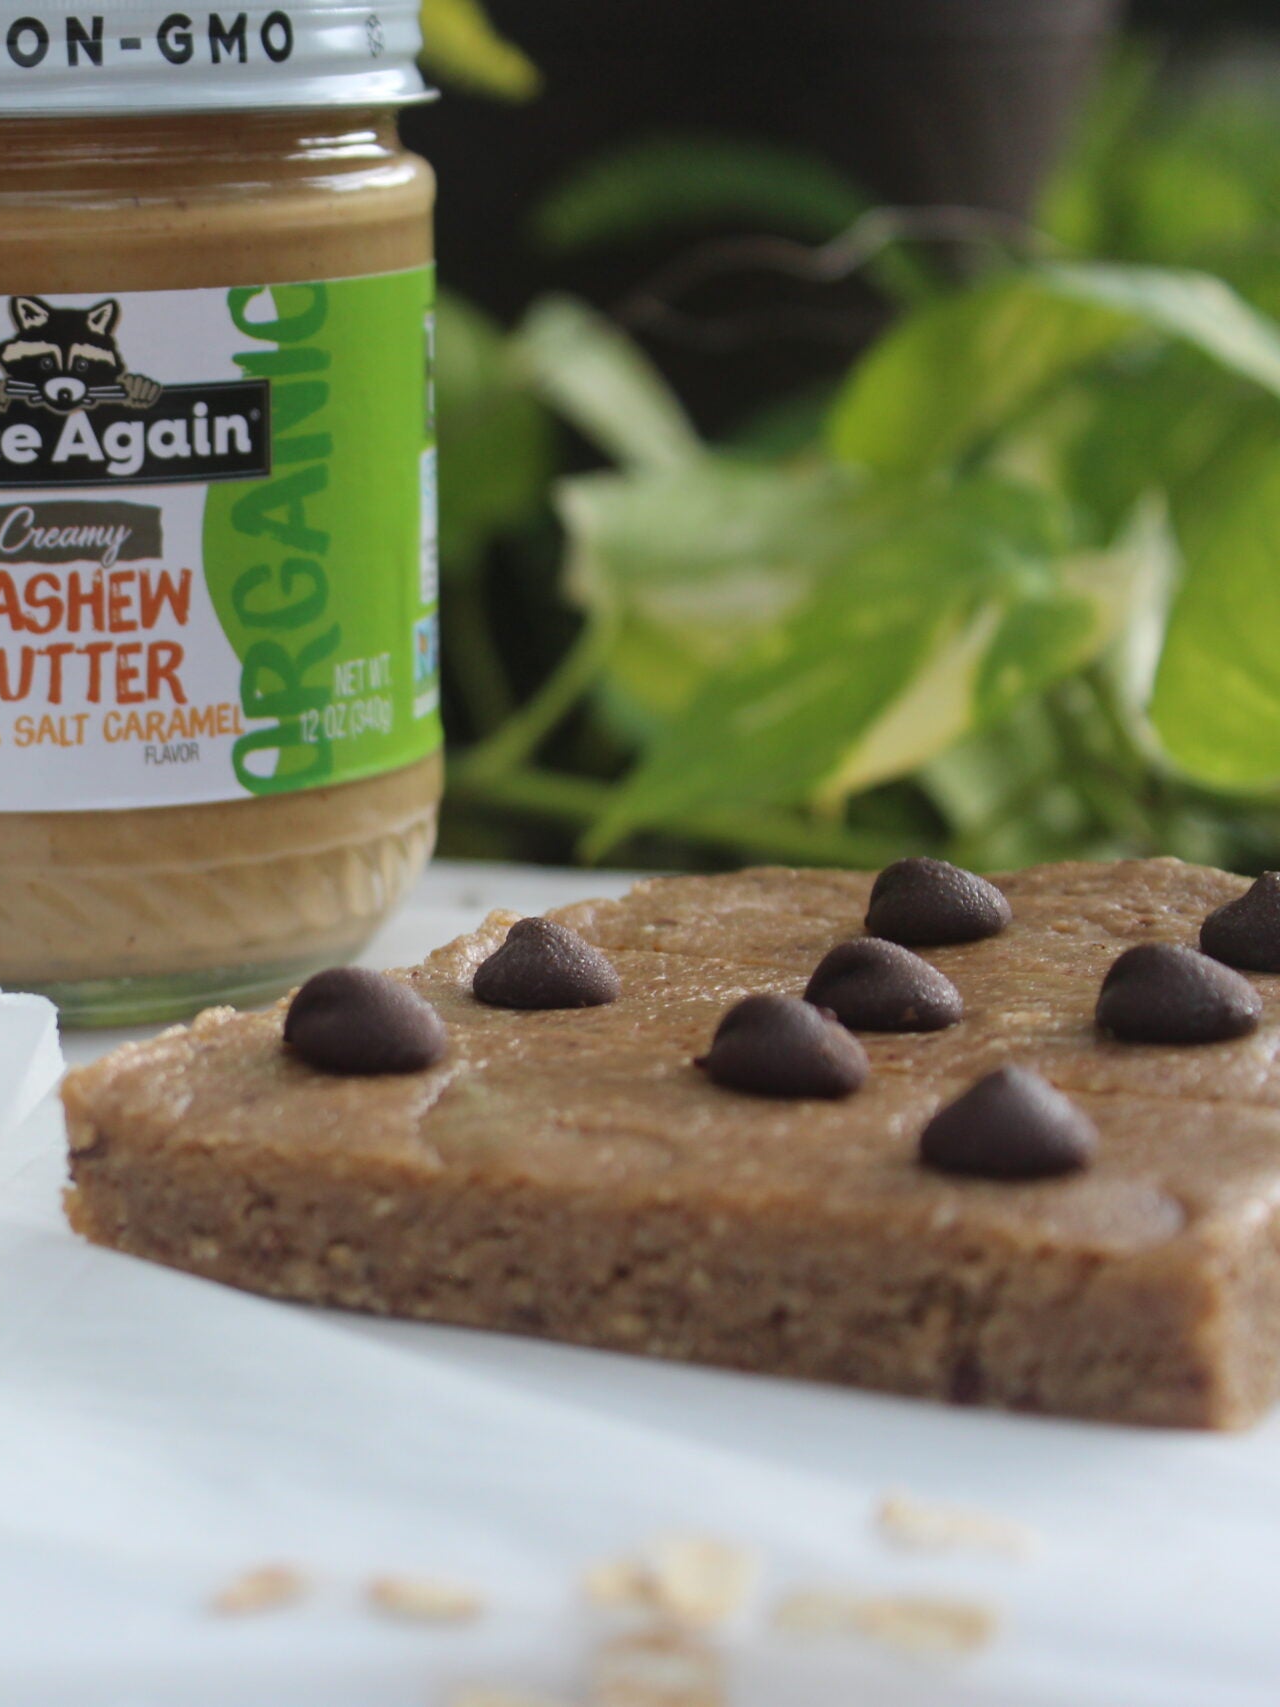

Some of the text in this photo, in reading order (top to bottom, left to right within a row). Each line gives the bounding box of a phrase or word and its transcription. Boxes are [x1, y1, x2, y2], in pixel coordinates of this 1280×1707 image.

[51, 401, 252, 476] Again
[334, 658, 366, 697] NET
[13, 712, 91, 748] SALT
[102, 702, 246, 745] CARAMEL
[300, 708, 320, 743] 12
[323, 702, 348, 740] OZ
[143, 741, 201, 766] FLAVOR
